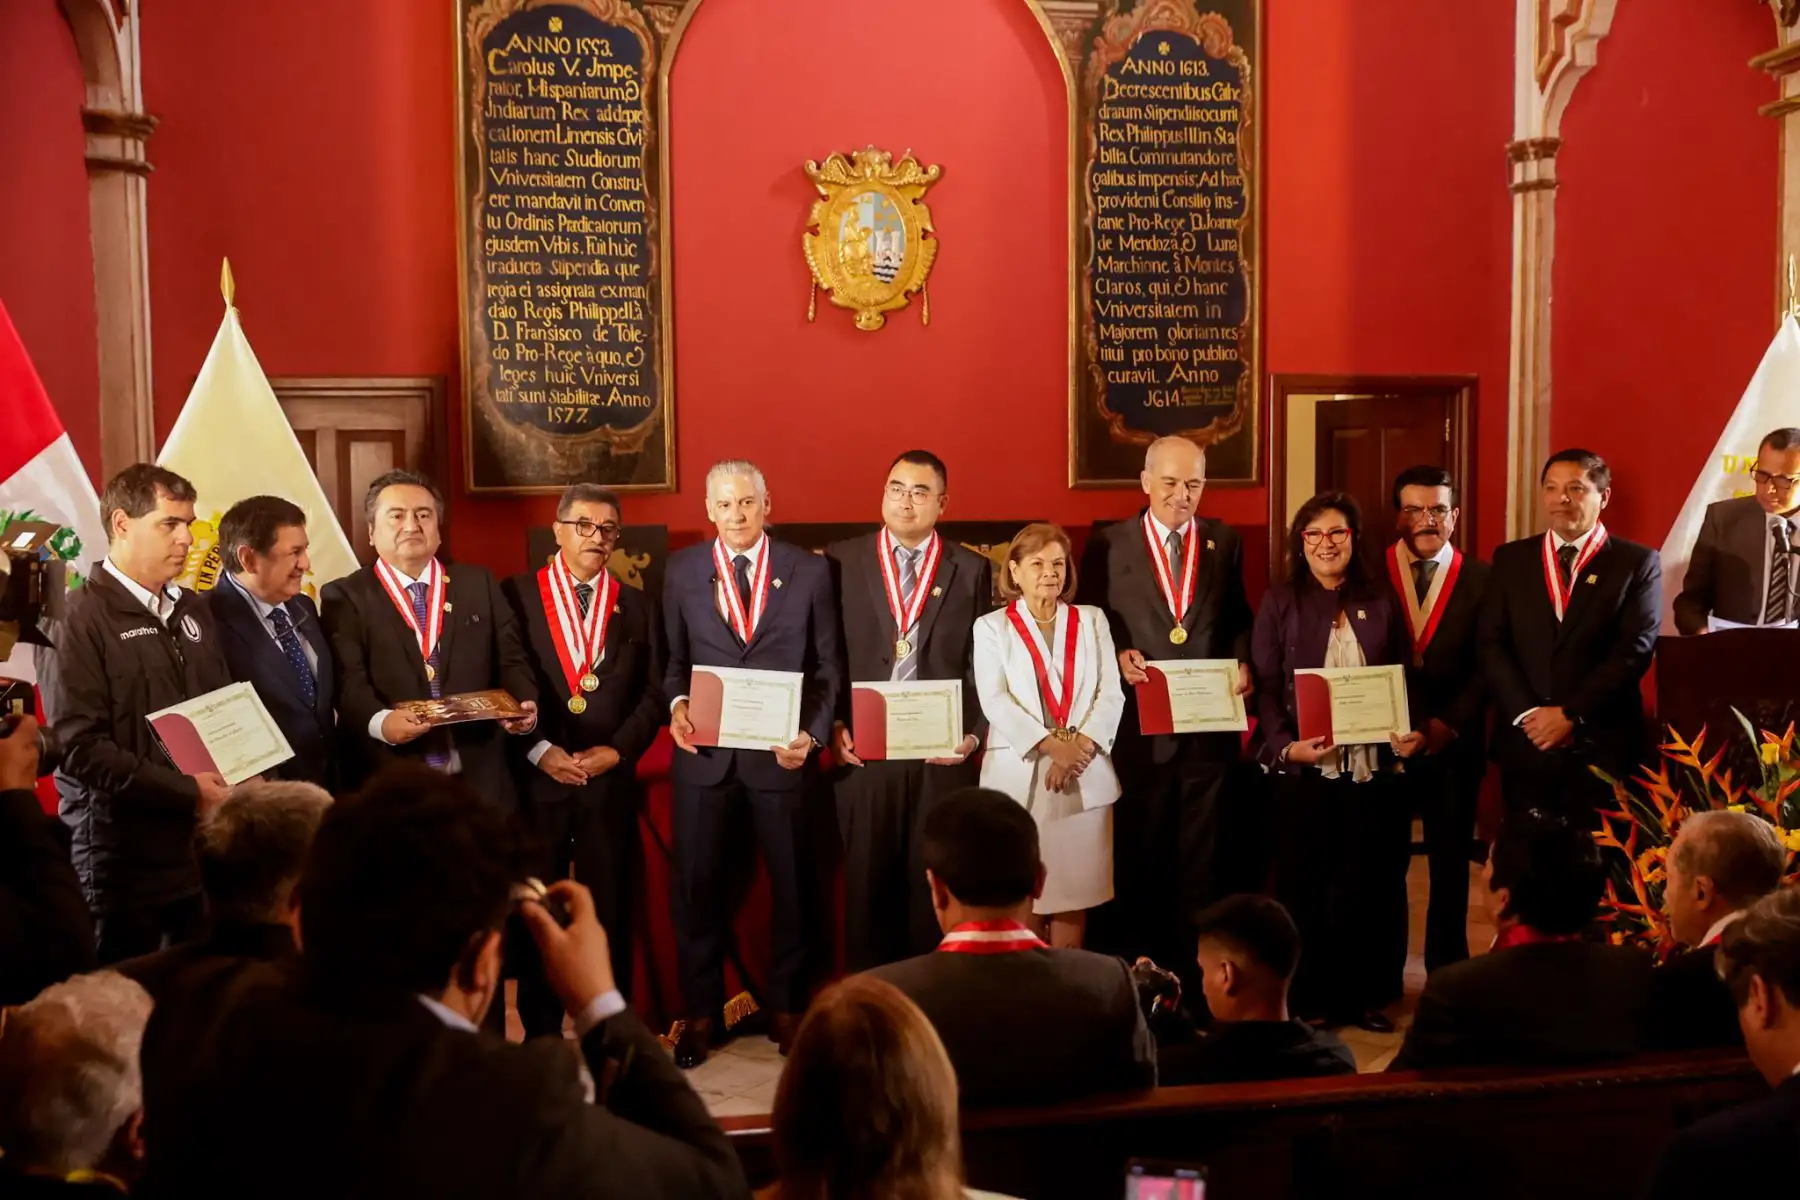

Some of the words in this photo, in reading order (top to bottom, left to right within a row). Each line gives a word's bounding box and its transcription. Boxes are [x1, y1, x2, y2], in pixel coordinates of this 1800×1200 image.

[506, 33, 571, 55] ANNO
[488, 48, 555, 76] Carolus
[561, 57, 580, 77] V.
[1120, 56, 1175, 76] ANNO
[1103, 74, 1211, 101] Decrescentibus
[562, 101, 590, 121] Rex
[488, 124, 555, 144] cationem
[556, 123, 615, 146] Limensis
[1100, 123, 1124, 142] Rex
[490, 148, 518, 165] tatis
[523, 147, 560, 167] hanc
[564, 148, 641, 169] Studiorum
[1093, 170, 1136, 193] galibus
[1198, 170, 1218, 187] Ad
[515, 191, 582, 211] mandavit
[585, 194, 597, 211] in
[1097, 192, 1160, 214] providenti
[1162, 189, 1211, 209] Consilio
[487, 213, 501, 230] tu
[505, 211, 554, 232] Ordinis
[485, 235, 539, 256] ejusdem
[585, 235, 609, 255] Fuit
[1097, 235, 1113, 251] de
[1207, 234, 1238, 251] Luna
[487, 258, 542, 276] traducta
[549, 259, 610, 280] Stipendia
[1097, 256, 1170, 274] Marchione
[1185, 255, 1234, 274] Montes
[537, 282, 596, 304] assignata
[1095, 277, 1146, 298] Claros,
[1193, 277, 1228, 296] hanc
[524, 300, 563, 328] Regis
[1205, 301, 1222, 319] in
[493, 320, 510, 341] D.
[516, 321, 582, 342] Fransisco
[593, 325, 609, 342] de
[1099, 324, 1158, 345] Majorem
[1167, 322, 1219, 346] gloriam
[493, 345, 510, 360] do
[1132, 349, 1153, 366] pro
[1155, 344, 1189, 362] bono
[1193, 346, 1238, 366] publico
[499, 364, 536, 389] leges
[580, 366, 640, 387] Vniversi
[1166, 362, 1219, 384] Anno
[519, 391, 547, 404] sunt
[607, 386, 650, 408] Anno
